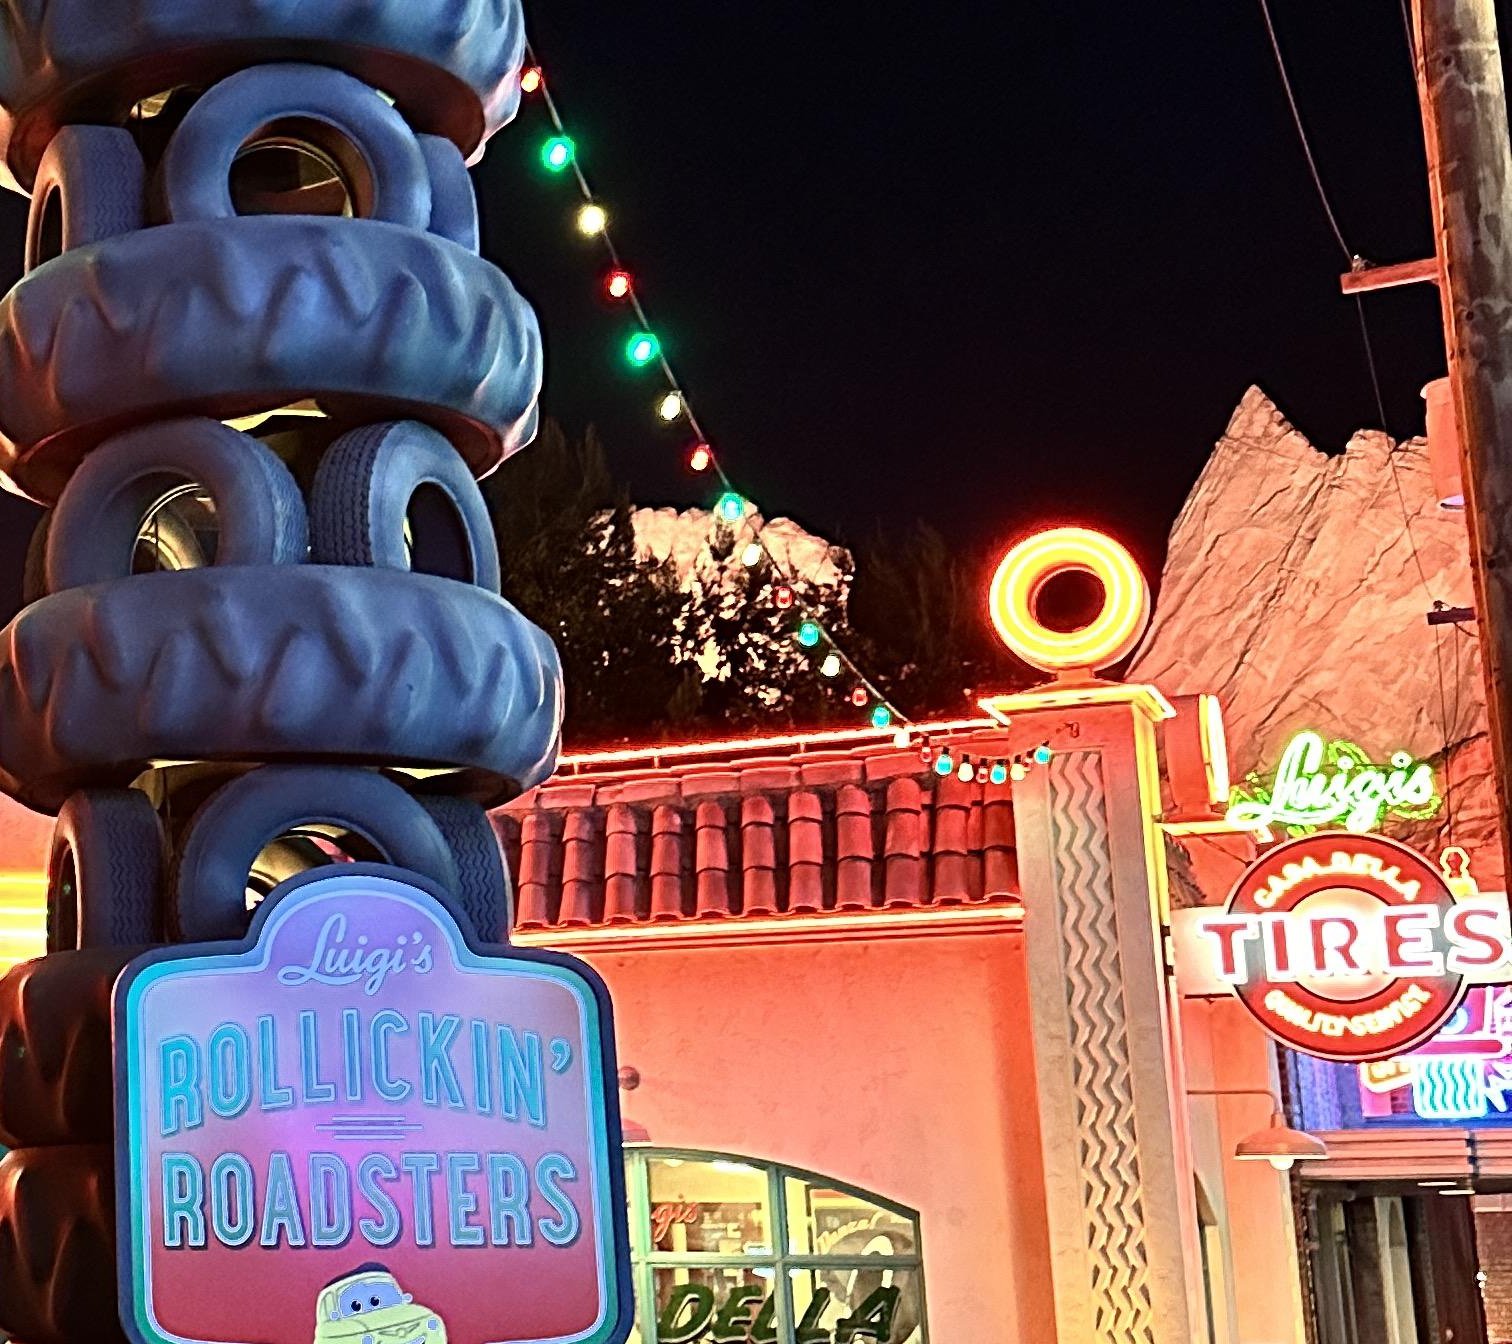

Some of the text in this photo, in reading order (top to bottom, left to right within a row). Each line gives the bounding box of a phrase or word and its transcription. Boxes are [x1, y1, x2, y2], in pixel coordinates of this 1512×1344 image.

[1254, 856, 1319, 908] CASA
[277, 912, 433, 996] Luigi's
[1198, 906, 1508, 979] TIRES
[158, 1008, 575, 1136] ROLLICKIN'
[162, 1151, 582, 1248] ROADSTERS
